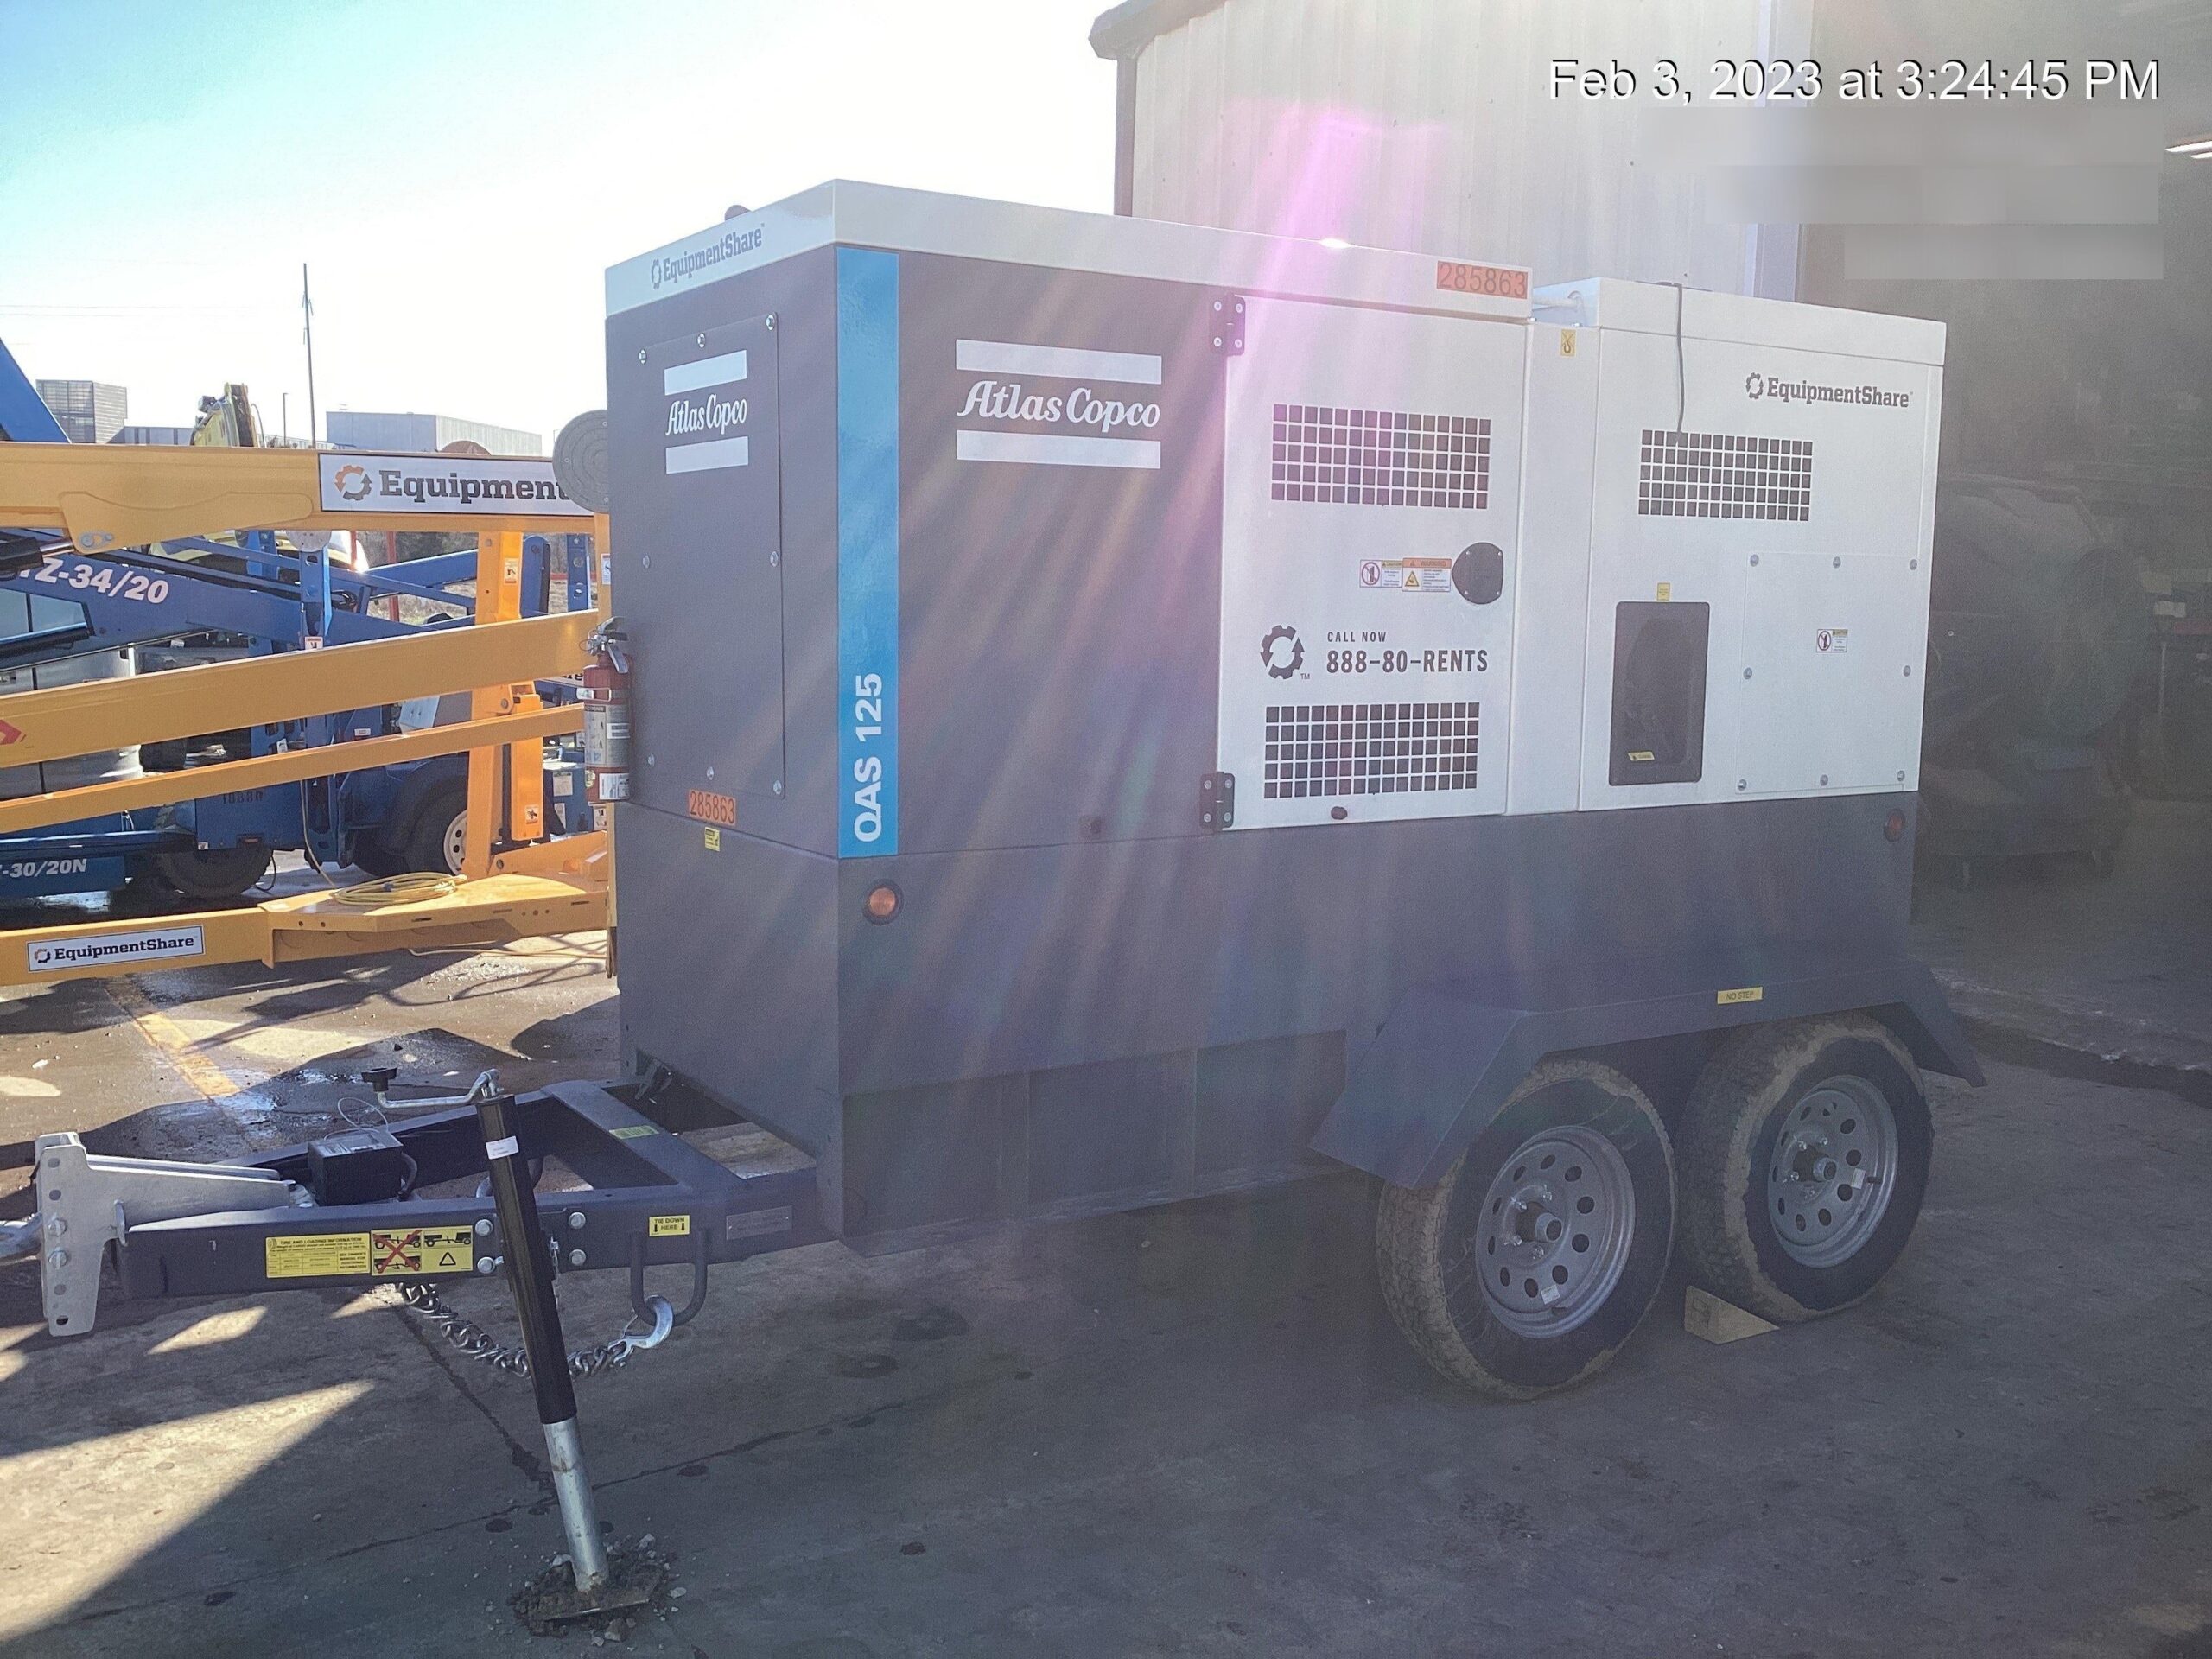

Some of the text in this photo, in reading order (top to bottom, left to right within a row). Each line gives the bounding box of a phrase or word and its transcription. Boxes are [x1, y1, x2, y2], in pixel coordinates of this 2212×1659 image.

[663, 227, 762, 283] EquipmentShare
[1438, 262, 1527, 297] 285863
[956, 380, 1160, 433] Atlas Copco
[1766, 377, 1910, 408] EquipmentShare
[664, 393, 747, 436] Atlas Copco
[19, 556, 170, 604] Z-34/20
[1327, 631, 1387, 643] CALL NOW
[1326, 649, 1489, 674] 888-80-RENTS
[854, 673, 883, 842] QAS 125
[690, 791, 734, 824] 285863
[0, 858, 87, 878] -30/20N
[54, 937, 194, 961] EquipmentShare
